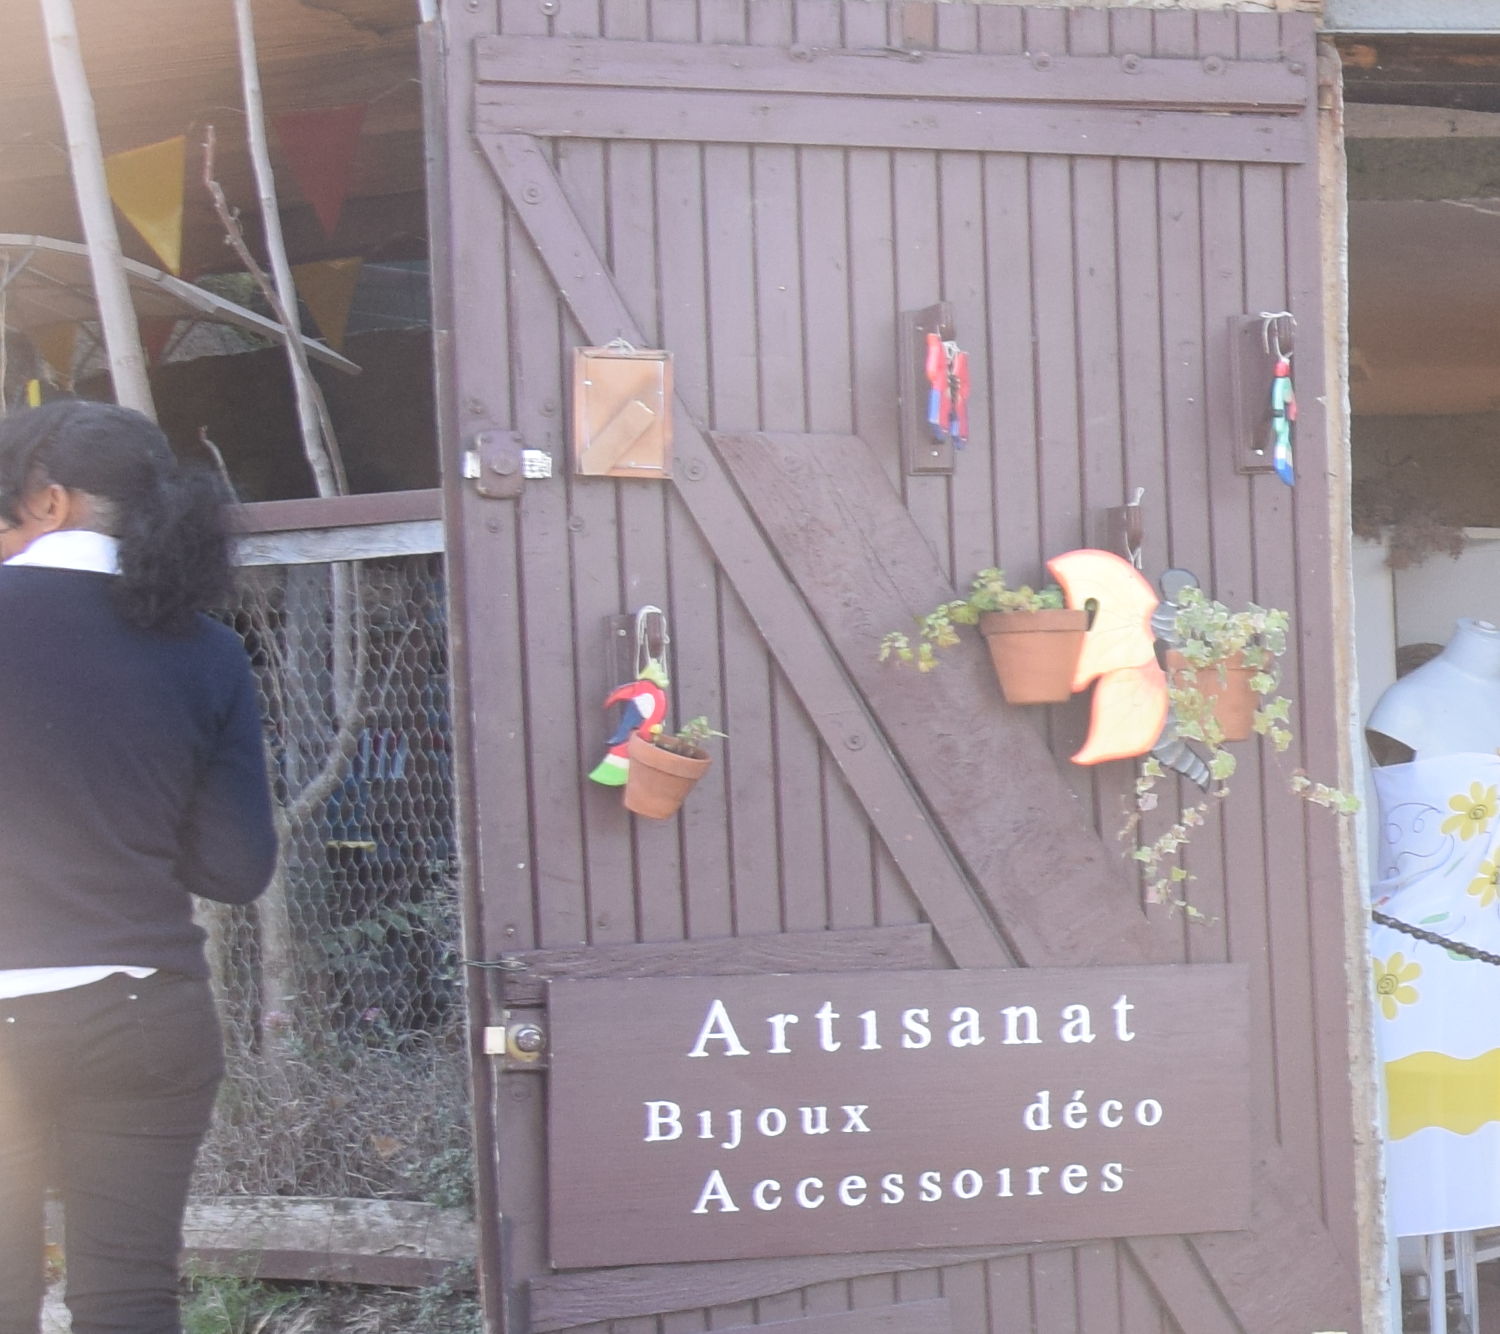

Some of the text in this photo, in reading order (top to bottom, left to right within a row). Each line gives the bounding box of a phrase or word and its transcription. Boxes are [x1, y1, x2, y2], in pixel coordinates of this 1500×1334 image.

[686, 993, 1136, 1058] Artisanat
[643, 1089, 1164, 1150] Bijoux déco
[691, 1162, 1125, 1214] Accessoires
